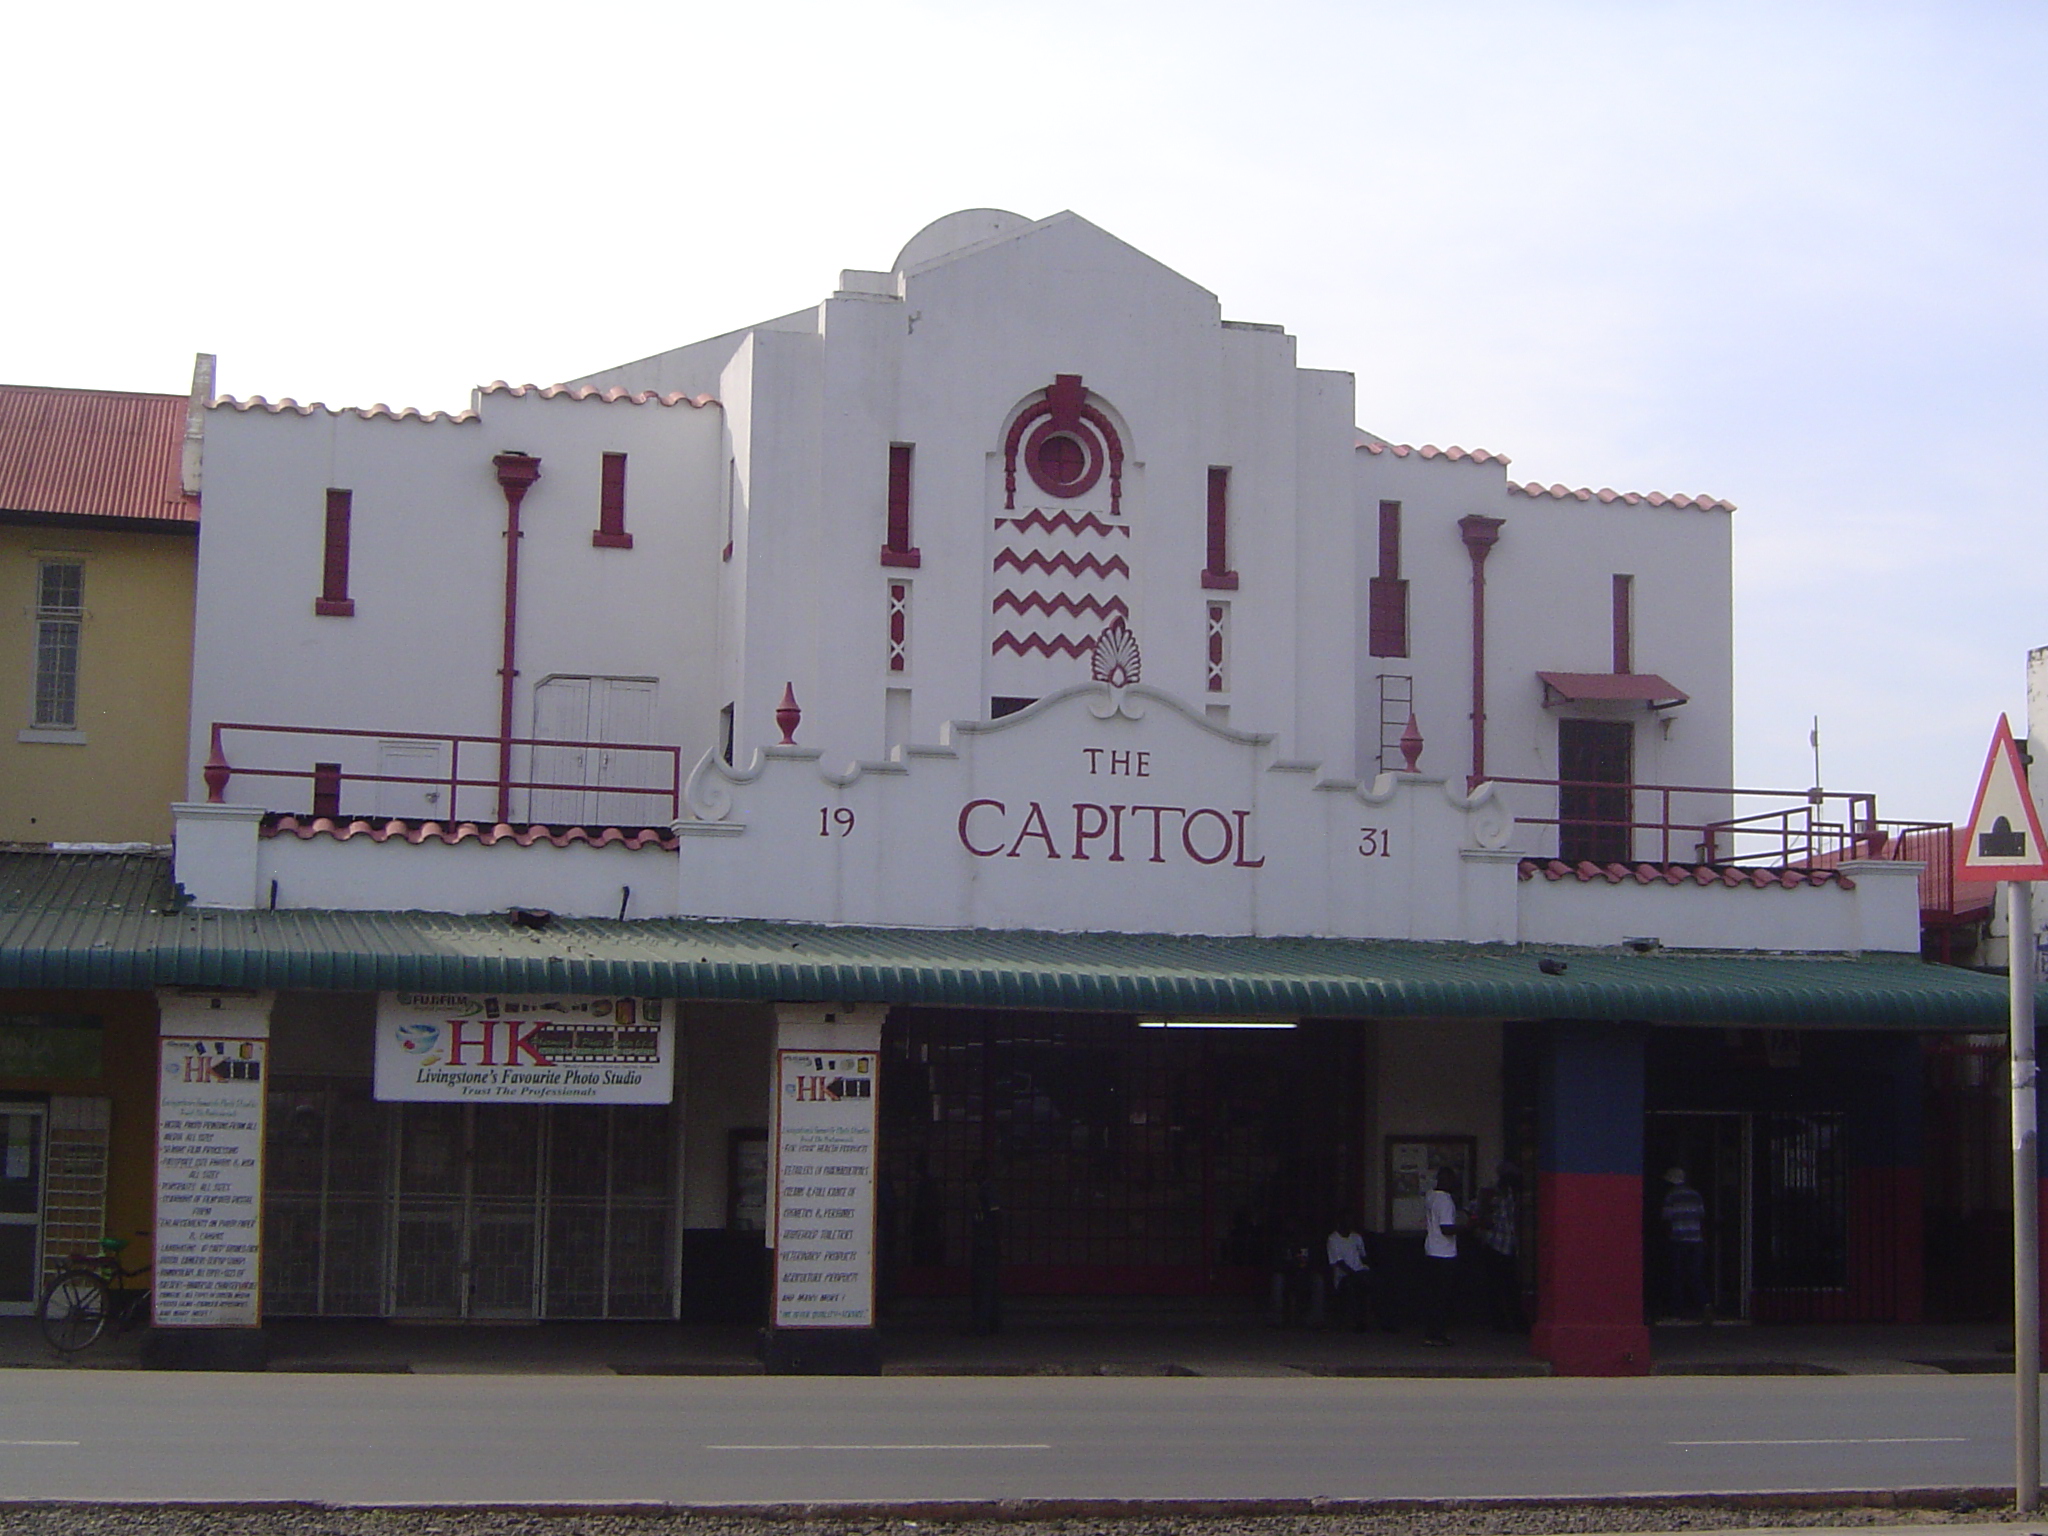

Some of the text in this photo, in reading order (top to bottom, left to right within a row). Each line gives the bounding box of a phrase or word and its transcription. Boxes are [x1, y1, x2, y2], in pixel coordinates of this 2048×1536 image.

[1083, 748, 1150, 777] THE
[819, 807, 855, 837] 19
[957, 798, 1266, 868] CAPITOL
[1358, 828, 1391, 858] 31
[445, 1020, 557, 1066] HK
[183, 1056, 229, 1083] HK
[416, 1069, 642, 1087] Livingstone's Favourite Photo Studio
[462, 1086, 597, 1097] Trust The Professionals
[796, 1075, 842, 1101] HK
